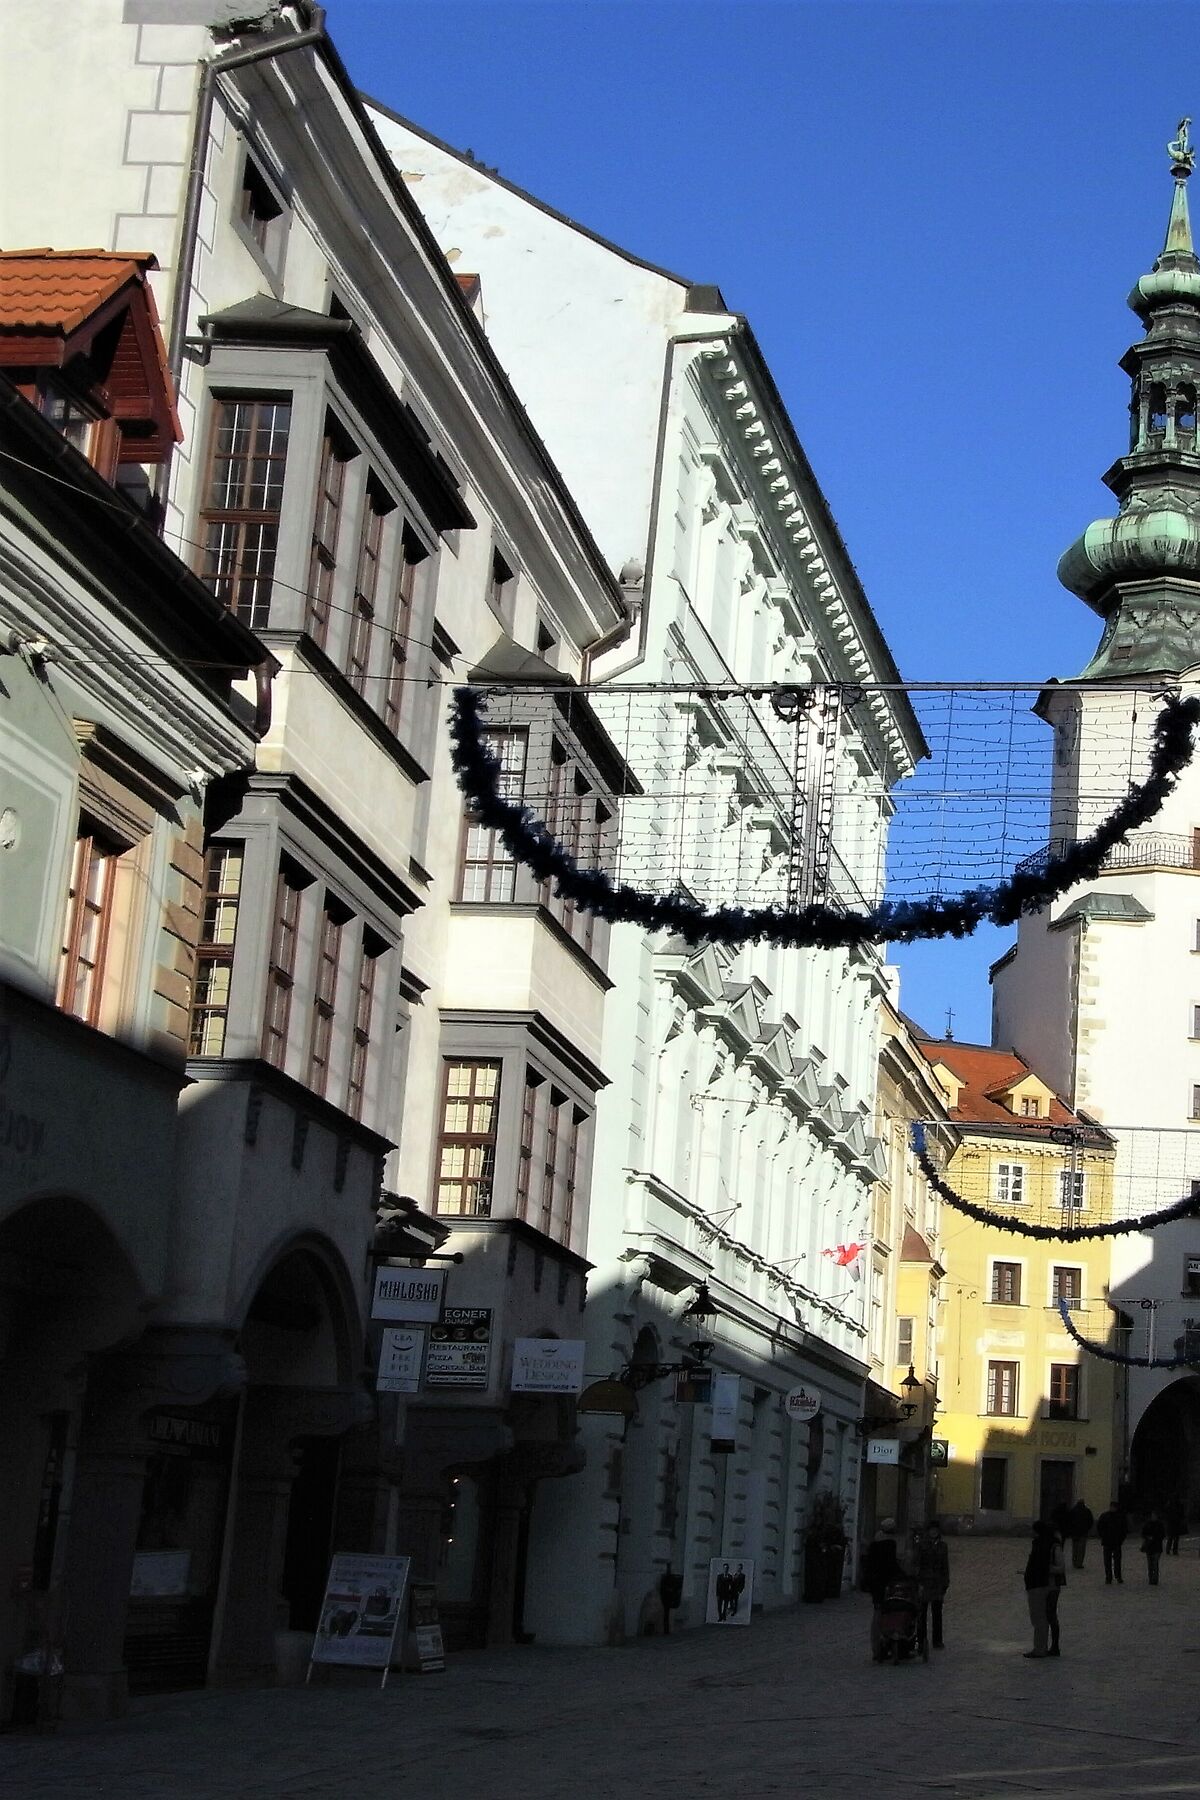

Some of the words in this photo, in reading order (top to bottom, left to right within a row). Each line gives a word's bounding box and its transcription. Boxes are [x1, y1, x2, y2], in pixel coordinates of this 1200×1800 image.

[444, 1309, 487, 1319] EGNER
[429, 1343, 488, 1351] RESTAURANT
[873, 1445, 893, 1455] Dior
